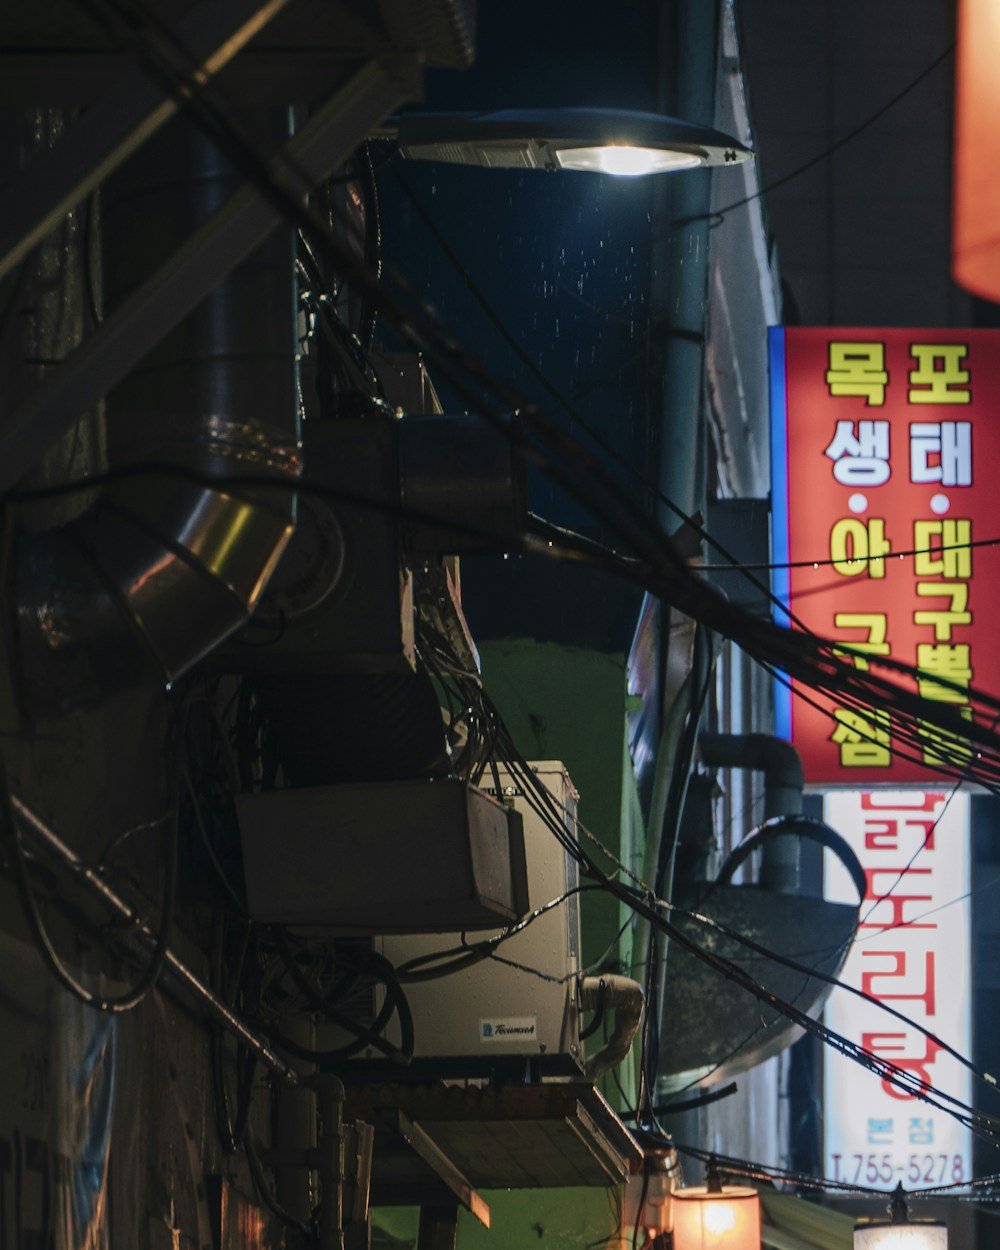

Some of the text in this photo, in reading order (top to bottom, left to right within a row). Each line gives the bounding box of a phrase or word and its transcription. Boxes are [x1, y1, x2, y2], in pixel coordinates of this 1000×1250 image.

[826, 343, 971, 406] 목포
[824, 420, 973, 487] 생태
[867, 1117, 935, 1145] 본점
